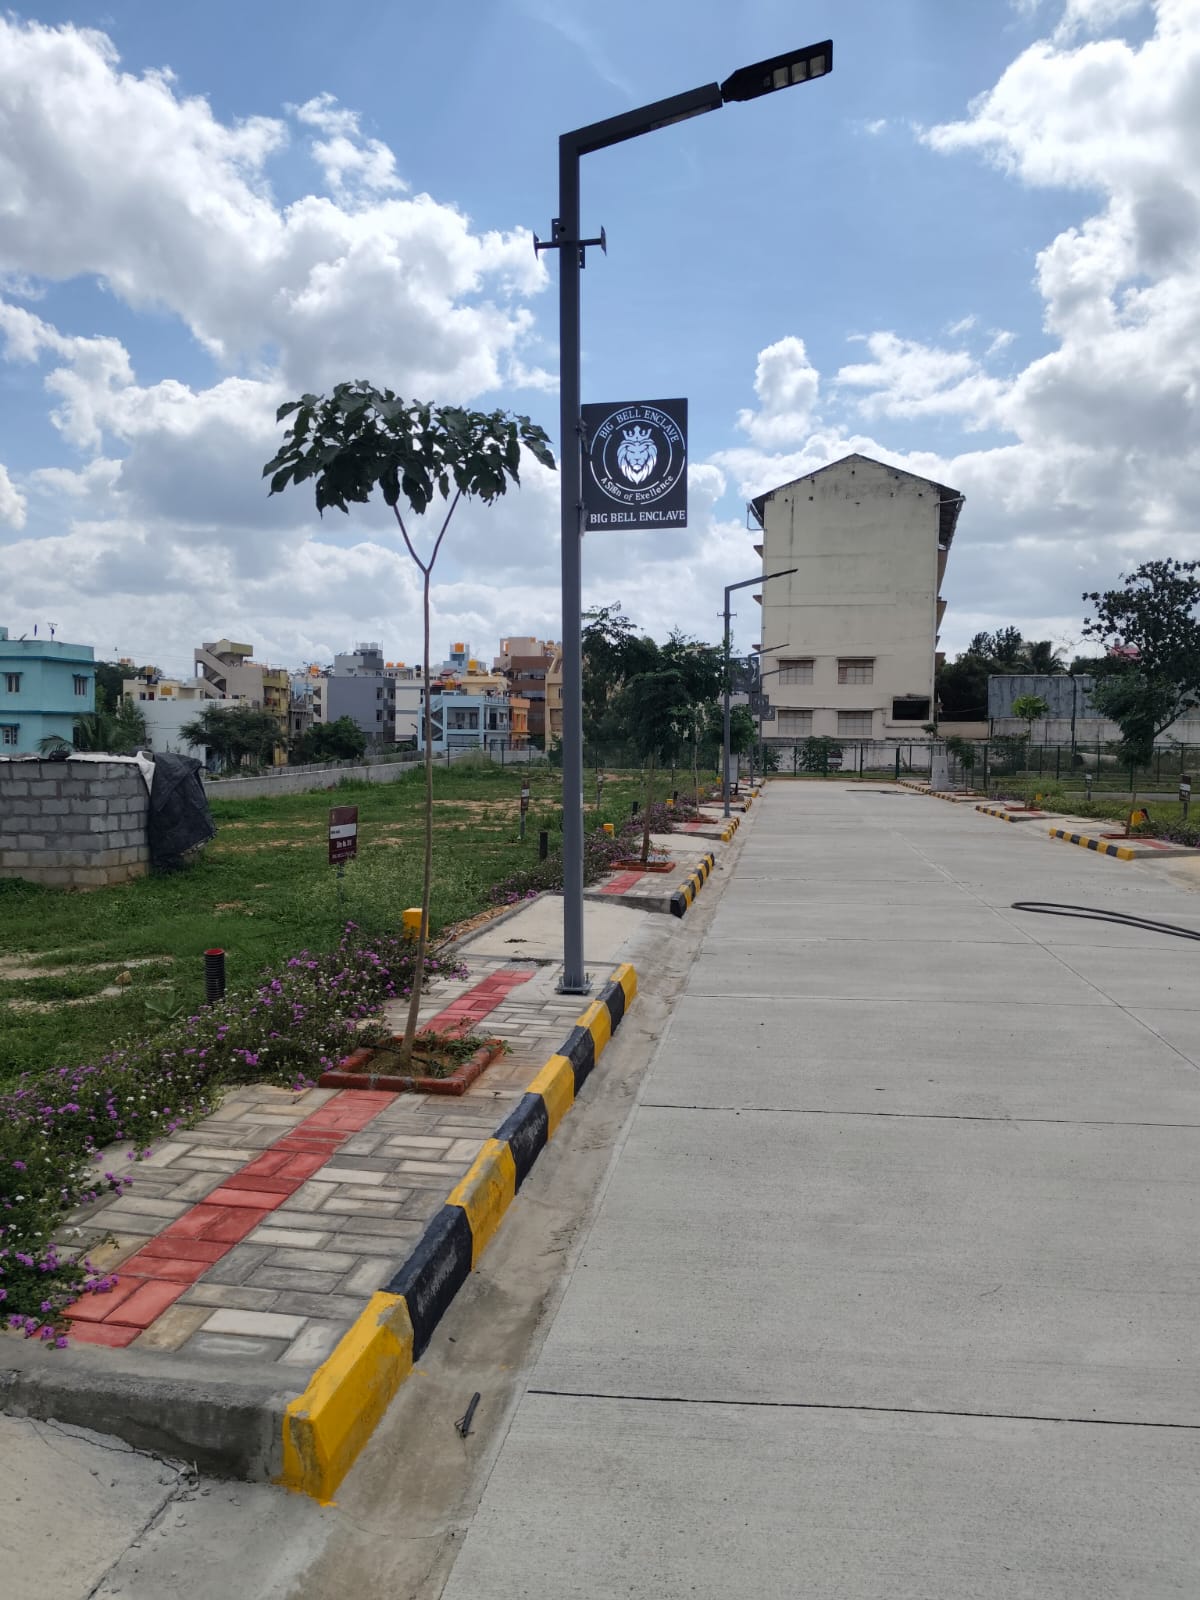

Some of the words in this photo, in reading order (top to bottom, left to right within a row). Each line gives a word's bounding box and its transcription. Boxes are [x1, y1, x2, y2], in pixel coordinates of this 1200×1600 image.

[599, 422, 614, 439] BIG
[616, 409, 641, 423] BELL
[644, 410, 679, 443] ENCLAVE
[605, 481, 621, 497] Sign
[624, 493, 632, 501] of
[590, 513, 608, 524] BIG
[610, 512, 636, 522] BELL
[639, 510, 686, 521] ENCLAVE
